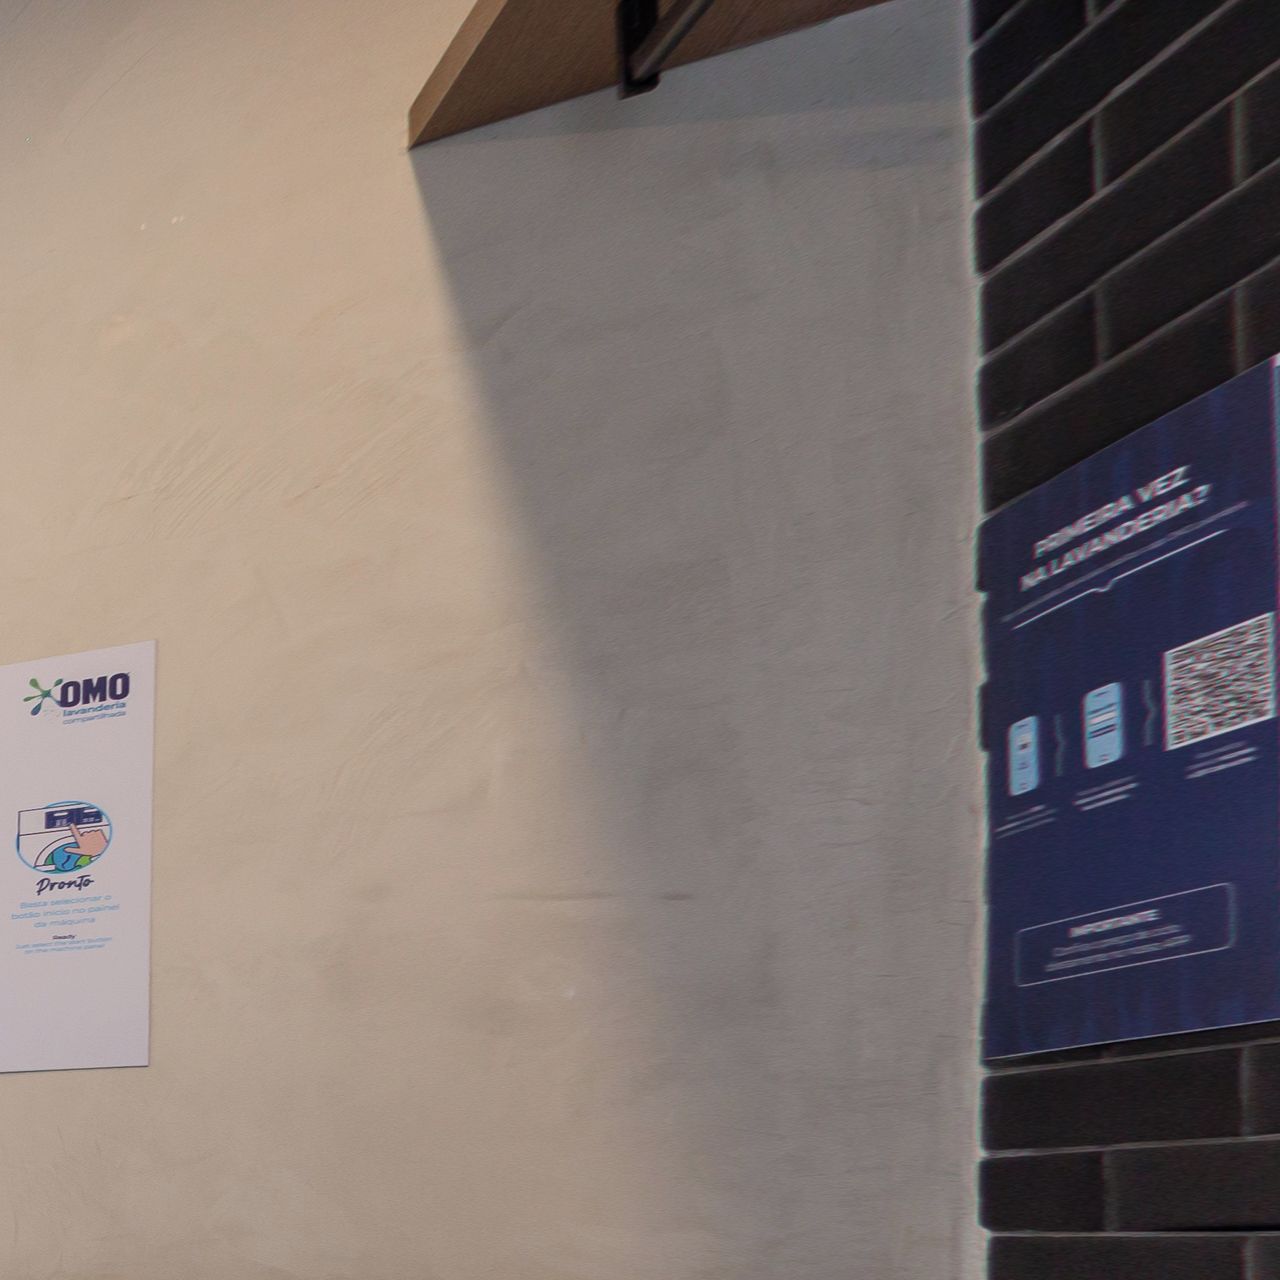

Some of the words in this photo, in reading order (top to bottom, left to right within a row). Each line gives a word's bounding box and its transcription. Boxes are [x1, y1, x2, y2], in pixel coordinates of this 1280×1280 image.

[1136, 465, 1190, 502] VEZ
[60, 673, 129, 707] OMO
[36, 875, 94, 896] Pronto
